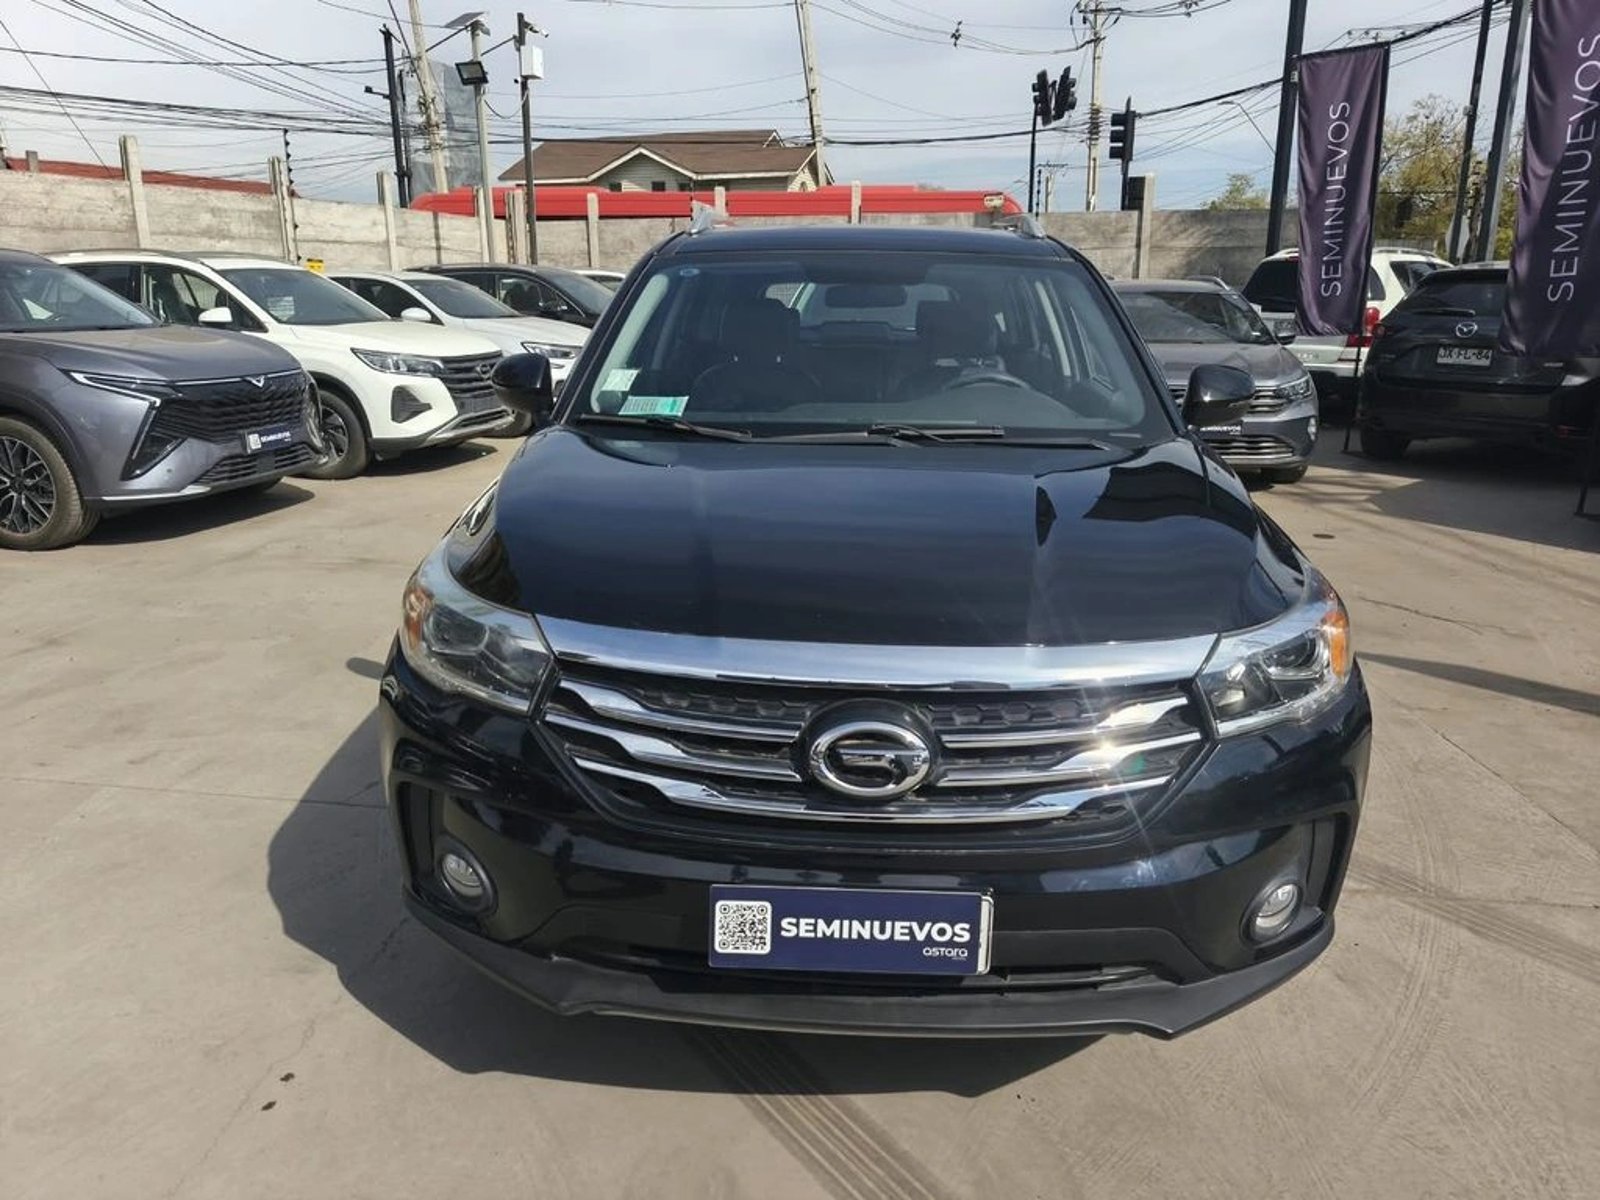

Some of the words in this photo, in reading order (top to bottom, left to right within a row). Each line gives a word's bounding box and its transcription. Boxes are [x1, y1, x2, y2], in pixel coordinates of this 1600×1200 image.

[1320, 102, 1351, 297] SEMINUEVOS
[1547, 33, 1600, 302] SEMINUEVOS
[780, 917, 971, 942] SEMINUEVOS
[922, 946, 968, 958] astara
